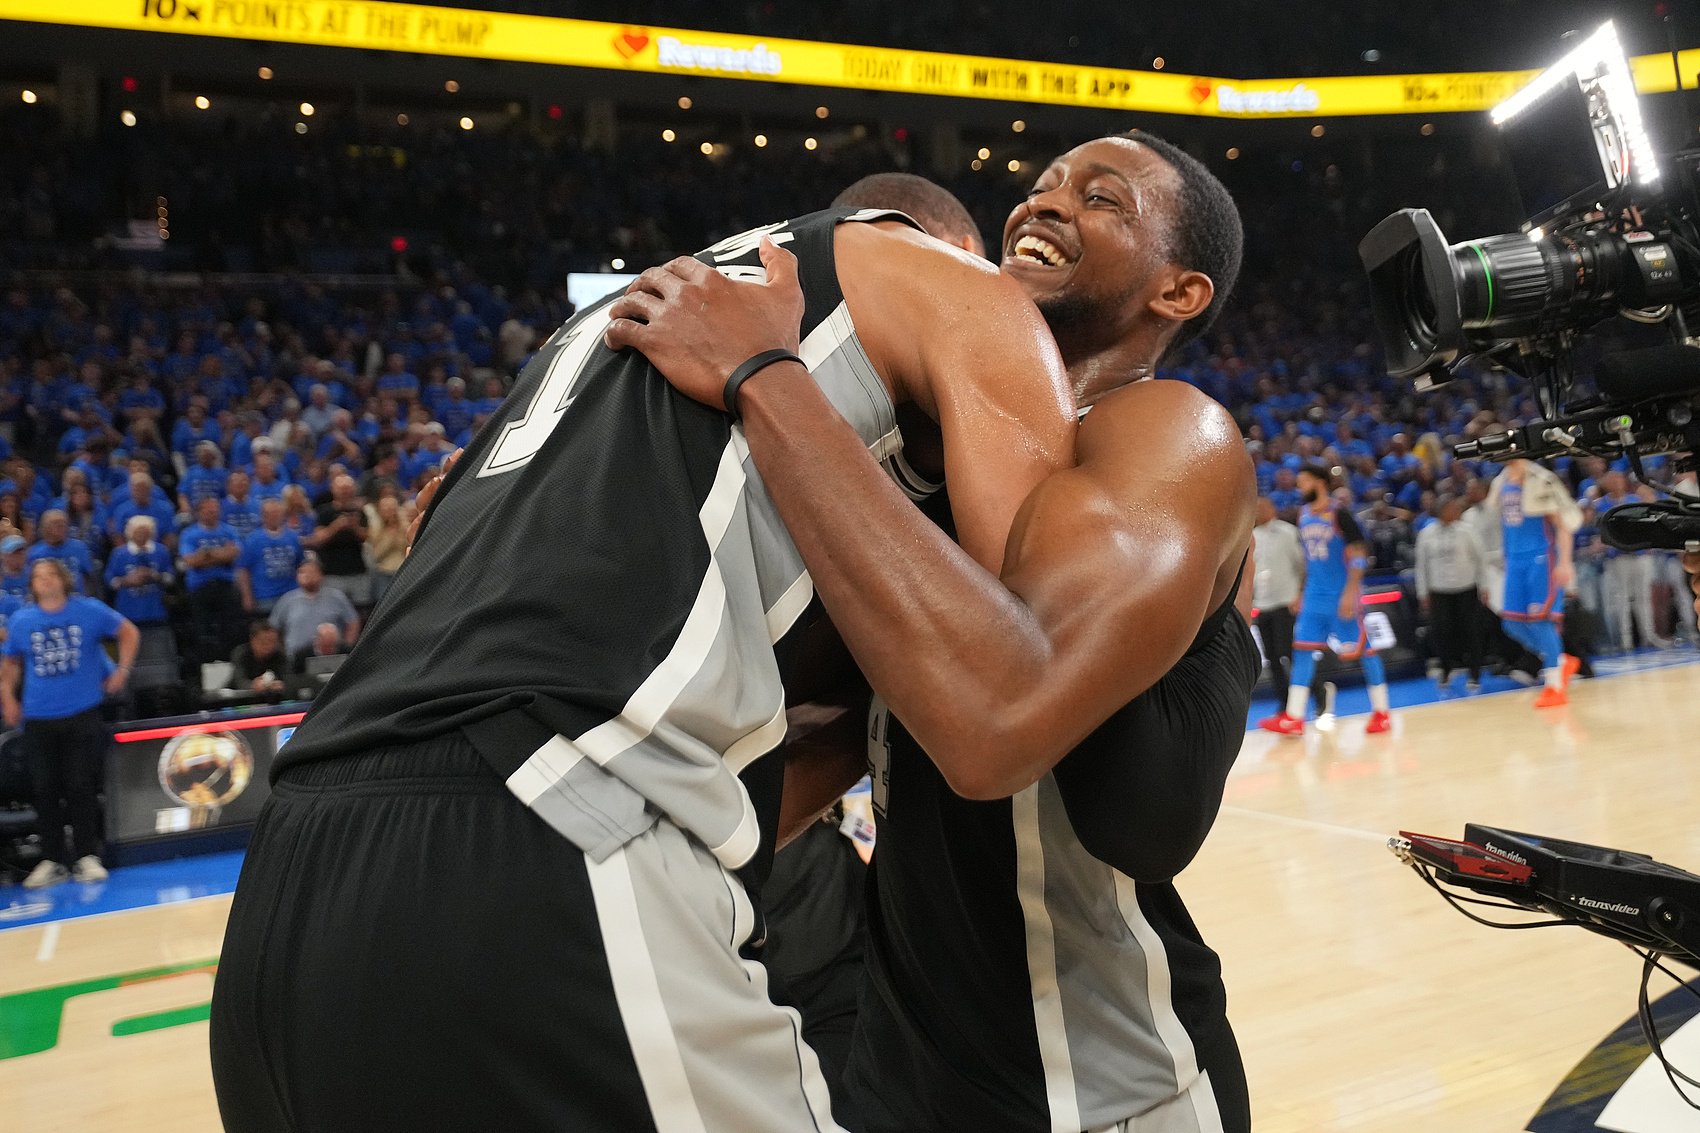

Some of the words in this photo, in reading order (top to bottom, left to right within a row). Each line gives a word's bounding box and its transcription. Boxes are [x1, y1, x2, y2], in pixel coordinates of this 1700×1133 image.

[211, 0, 310, 31] POINTS
[320, 8, 349, 34] AT
[365, 9, 409, 40] THE
[419, 15, 489, 46] PUMP
[657, 35, 782, 75] Rewards
[1090, 78, 1131, 97] APP
[476, 297, 624, 478] 1
[1578, 896, 1640, 916] transvideo
